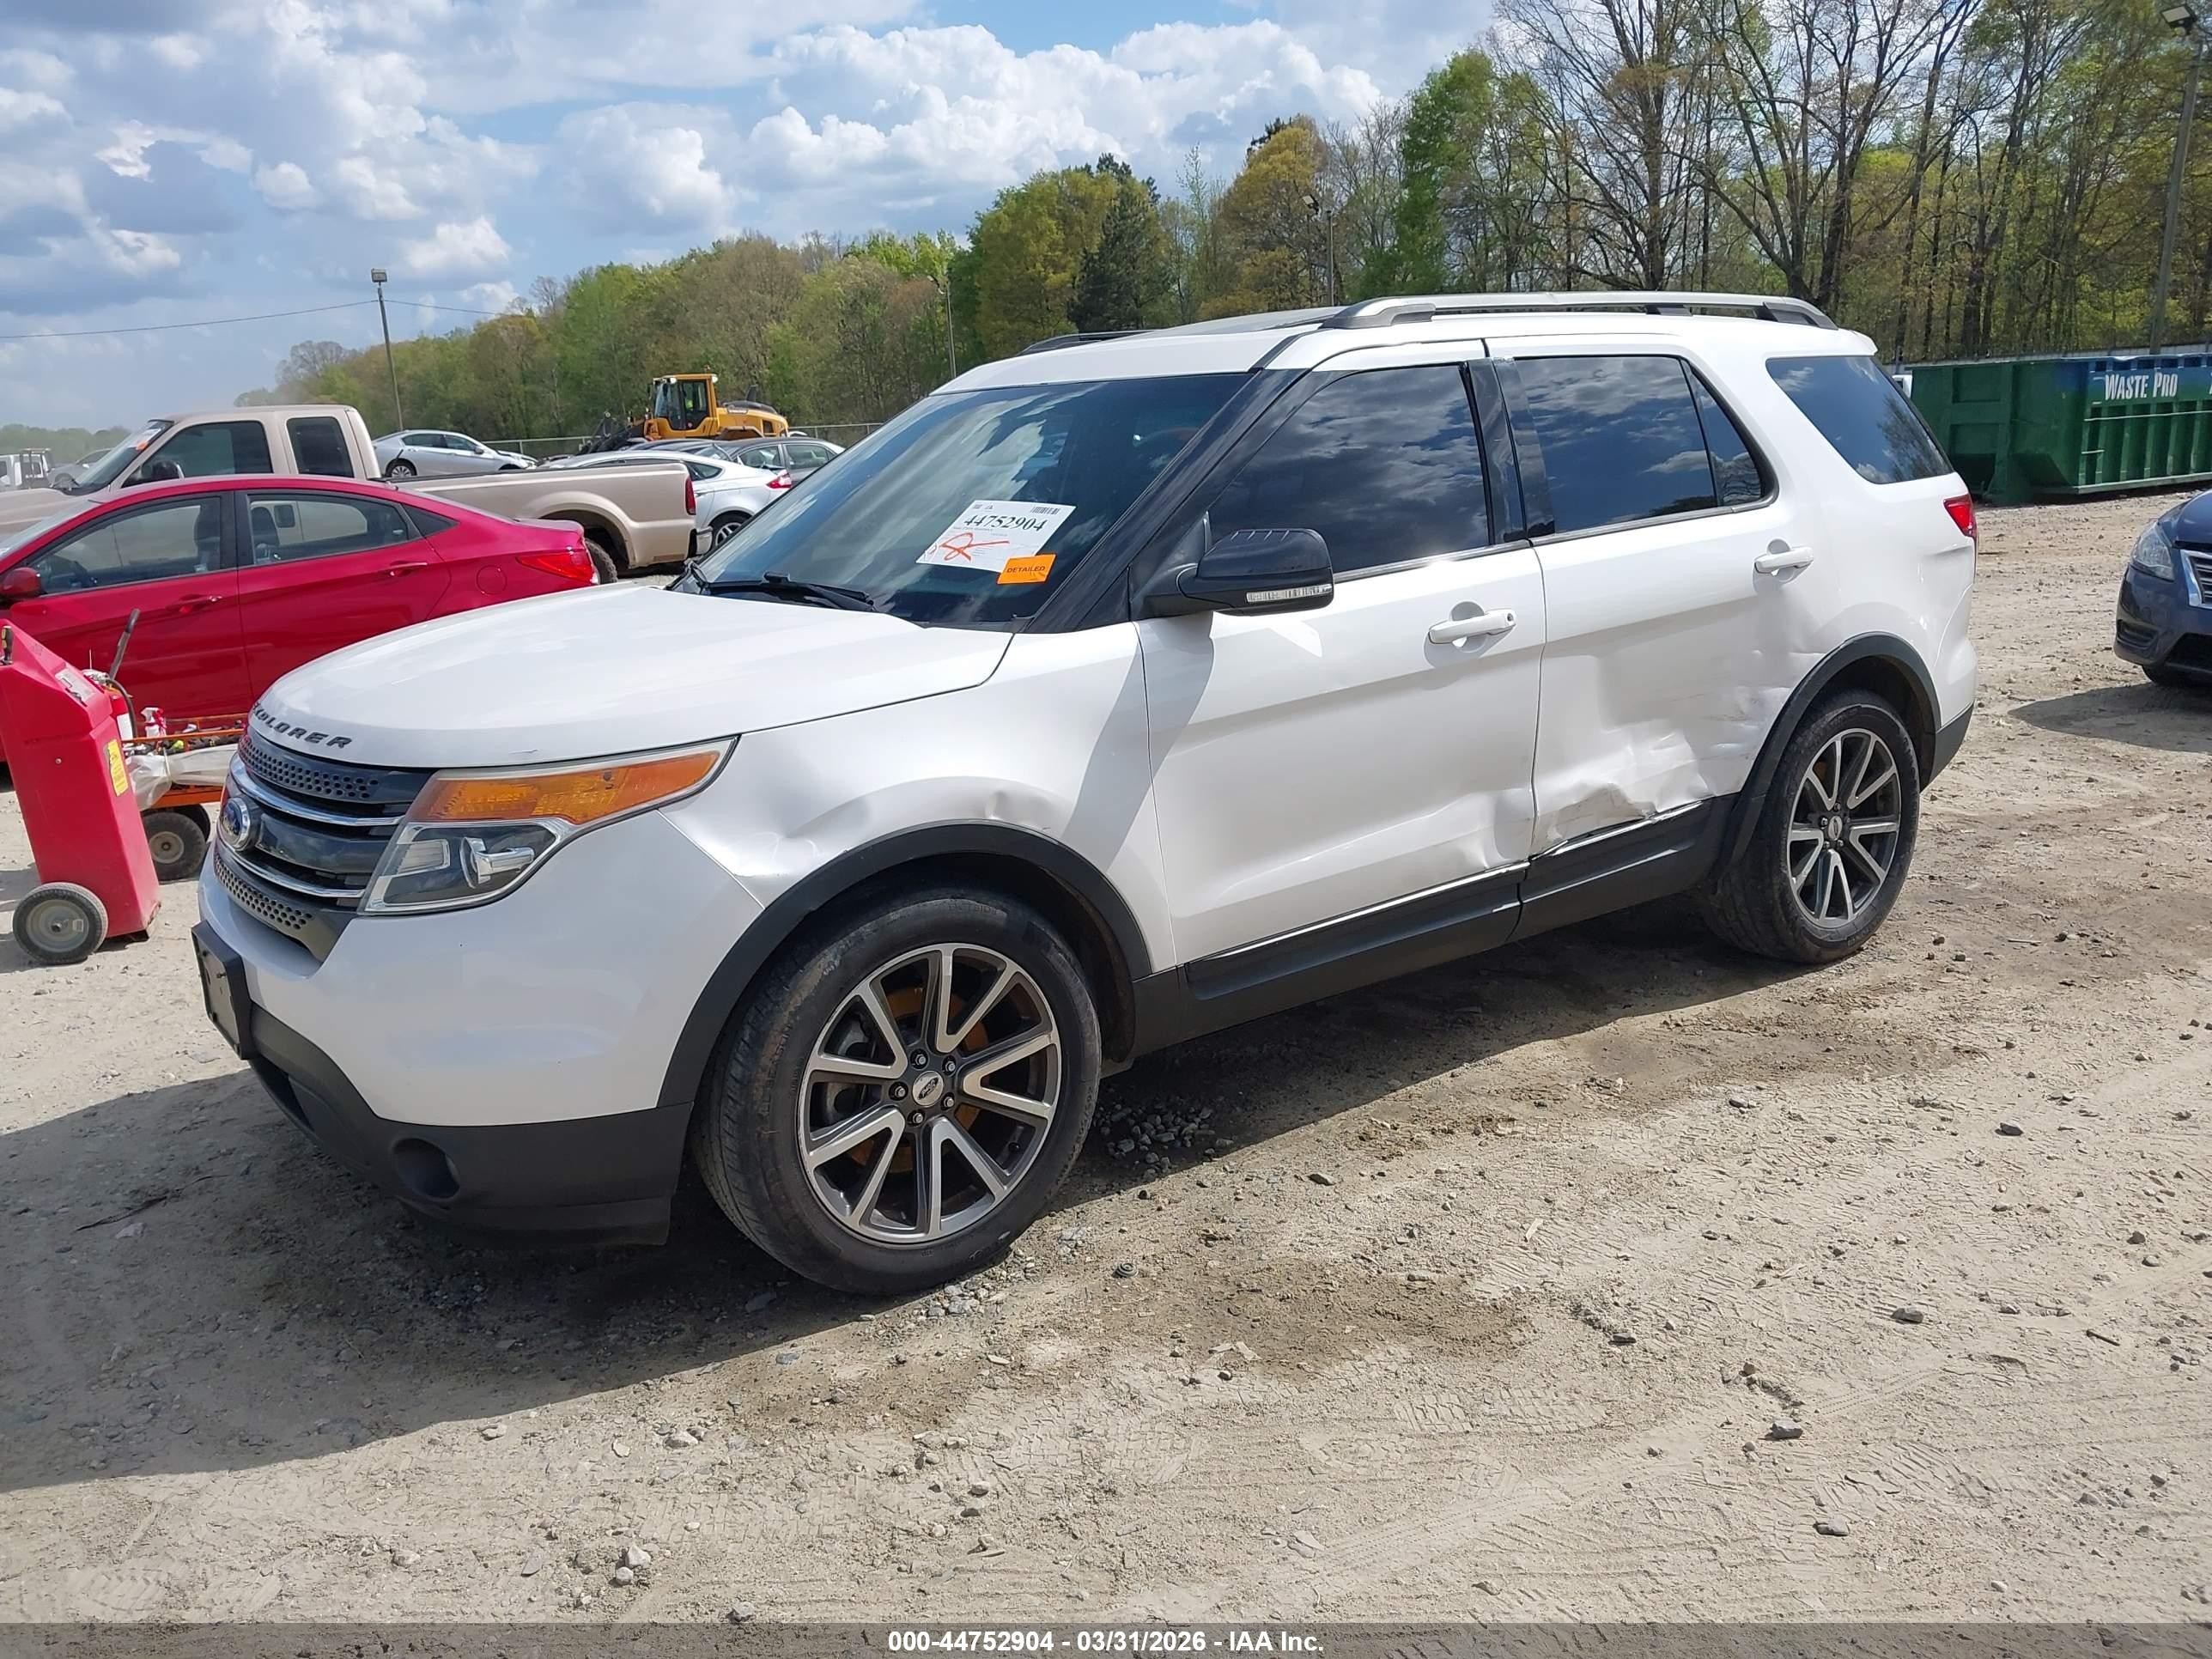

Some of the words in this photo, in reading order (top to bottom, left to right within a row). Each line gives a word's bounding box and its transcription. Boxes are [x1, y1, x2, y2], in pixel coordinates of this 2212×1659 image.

[2105, 374, 2149, 400] WASTE
[2153, 372, 2178, 398] PRO
[963, 515, 1048, 532] 44752904
[1006, 565, 1046, 574] DETAILED
[253, 702, 352, 749] XPLORER
